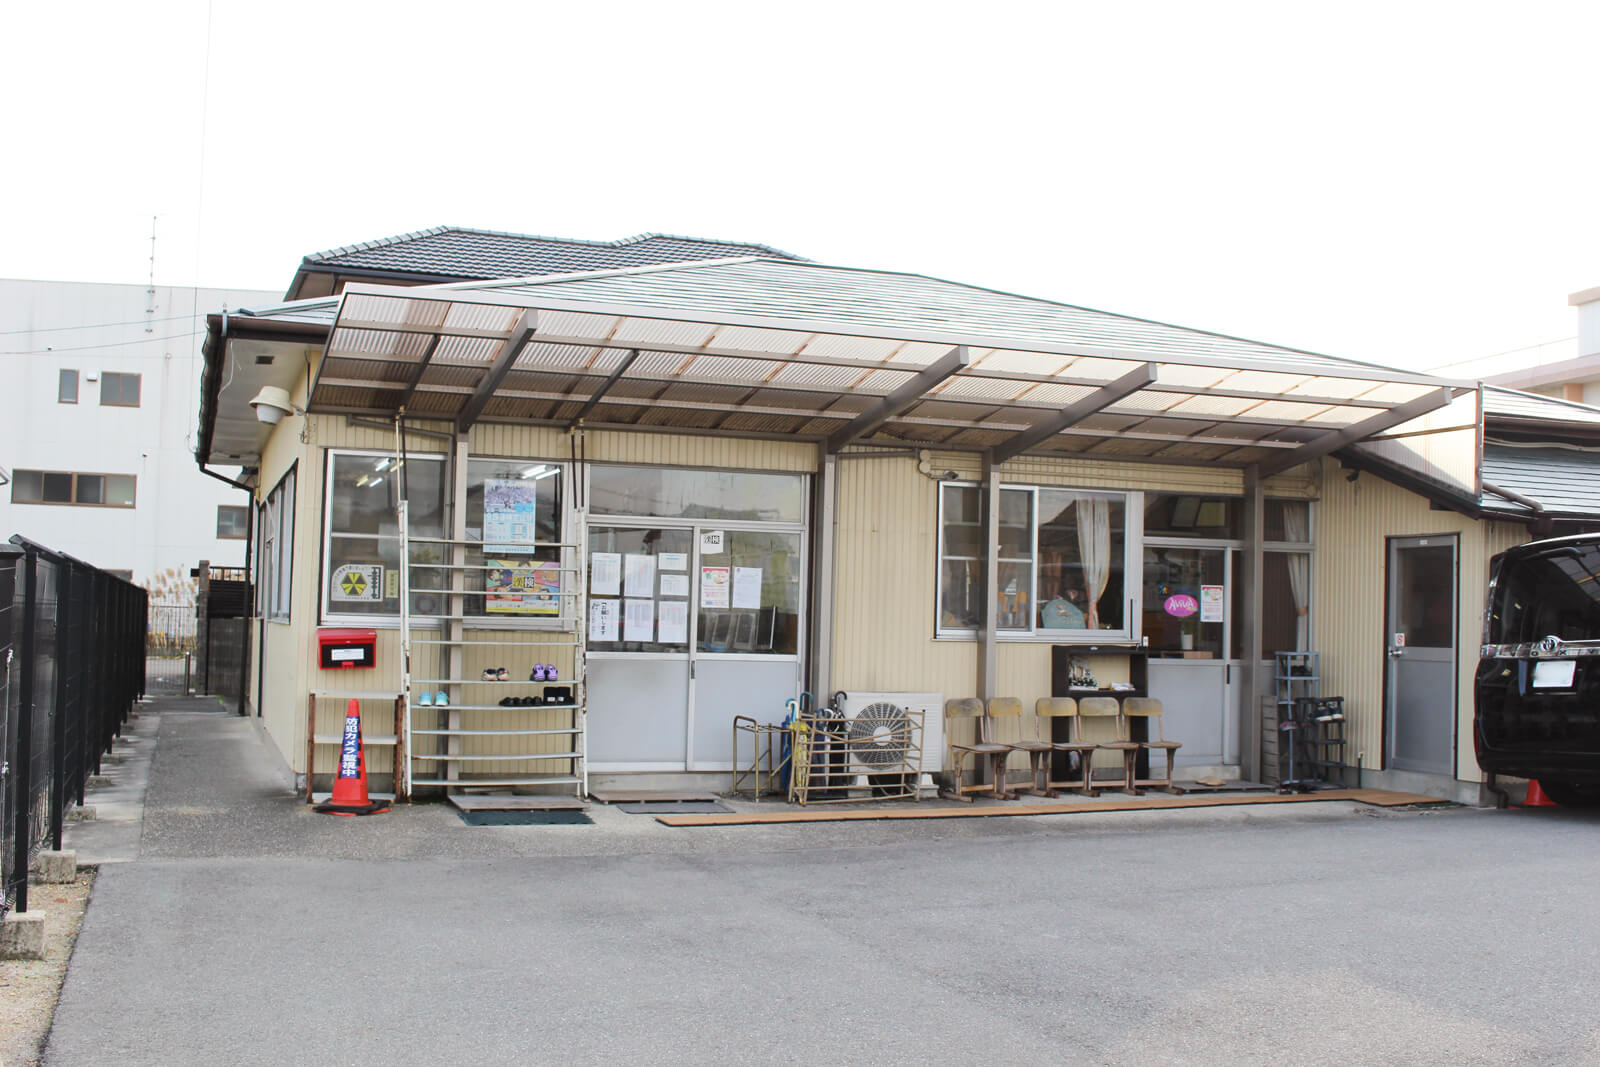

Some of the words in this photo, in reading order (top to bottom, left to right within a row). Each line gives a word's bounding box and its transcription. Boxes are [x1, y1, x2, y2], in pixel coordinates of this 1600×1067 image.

[342, 717, 359, 777] 防犯カメラ監視中
